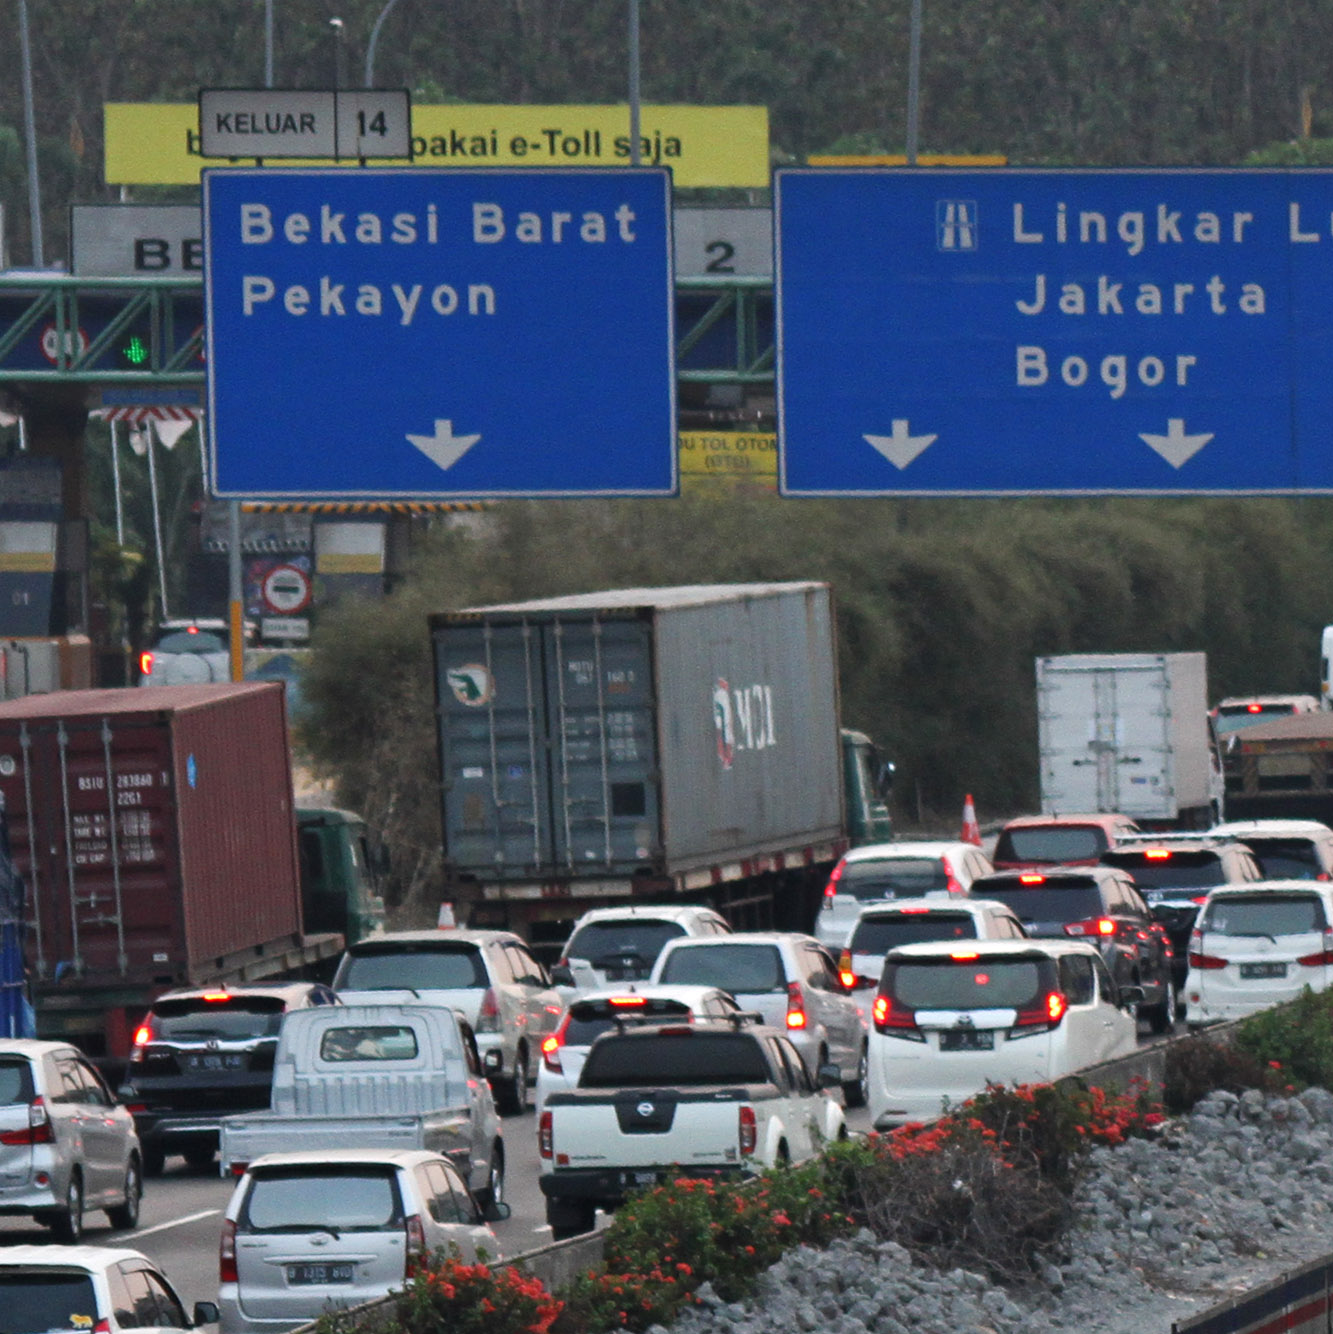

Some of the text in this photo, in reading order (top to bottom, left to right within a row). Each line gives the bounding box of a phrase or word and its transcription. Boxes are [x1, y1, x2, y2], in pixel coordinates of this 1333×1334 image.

[215, 110, 388, 138] KELUAR 14
[410, 129, 499, 161] pakai
[509, 129, 601, 158] e-Toll
[240, 204, 637, 244] Bekasi Barat
[1012, 203, 1254, 255] Lingkar
[704, 241, 735, 273] 2
[242, 278, 498, 325] Pekayon
[1015, 275, 1268, 316] Jakarta
[1016, 347, 1199, 399] Bogor
